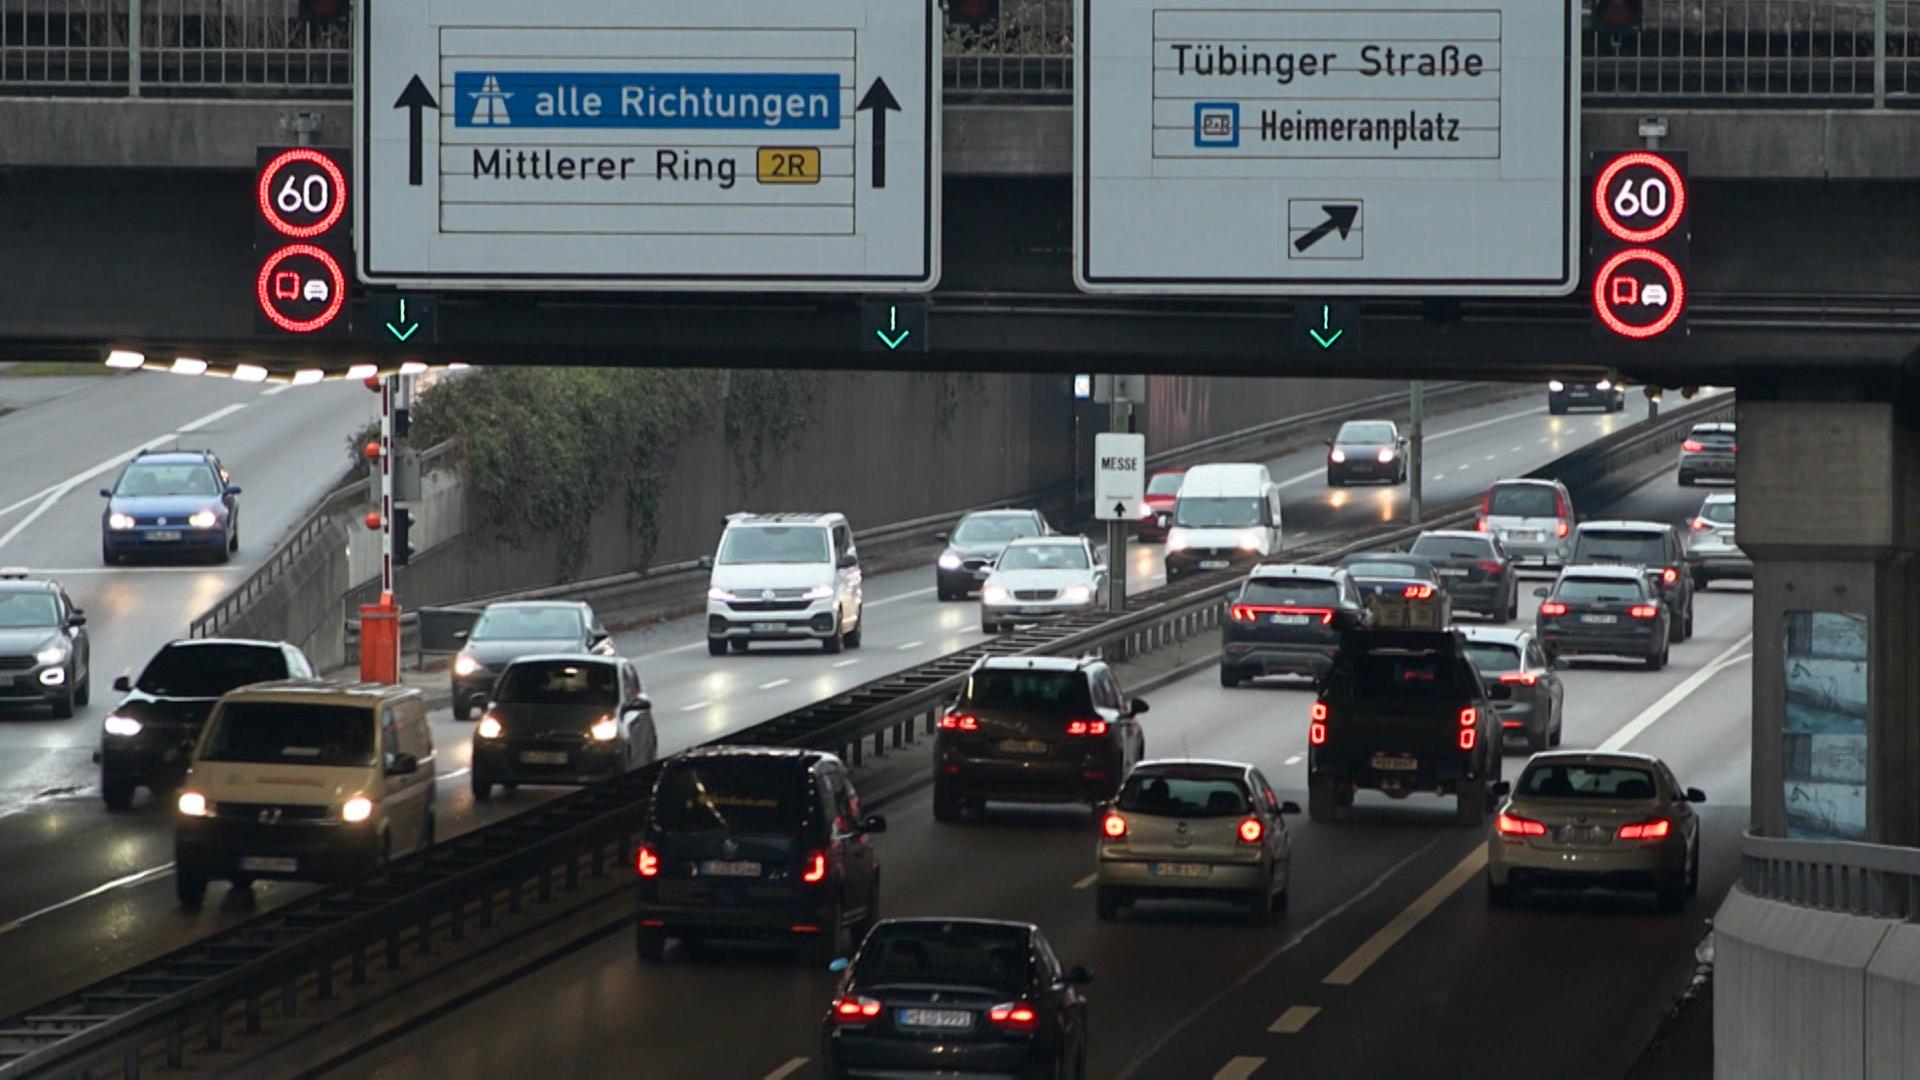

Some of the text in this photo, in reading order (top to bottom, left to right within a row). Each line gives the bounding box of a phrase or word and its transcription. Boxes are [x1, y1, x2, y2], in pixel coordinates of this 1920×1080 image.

[1171, 45, 1483, 84] Tübinger Straße
[535, 86, 829, 125] alle Richtungen
[1260, 110, 1459, 149] Heimeranplatz
[472, 149, 737, 189] Mittlerer Ring
[772, 155, 806, 177] 2R
[277, 174, 329, 213] 60
[1614, 178, 1667, 217] 60
[1101, 457, 1138, 471] MESSE
